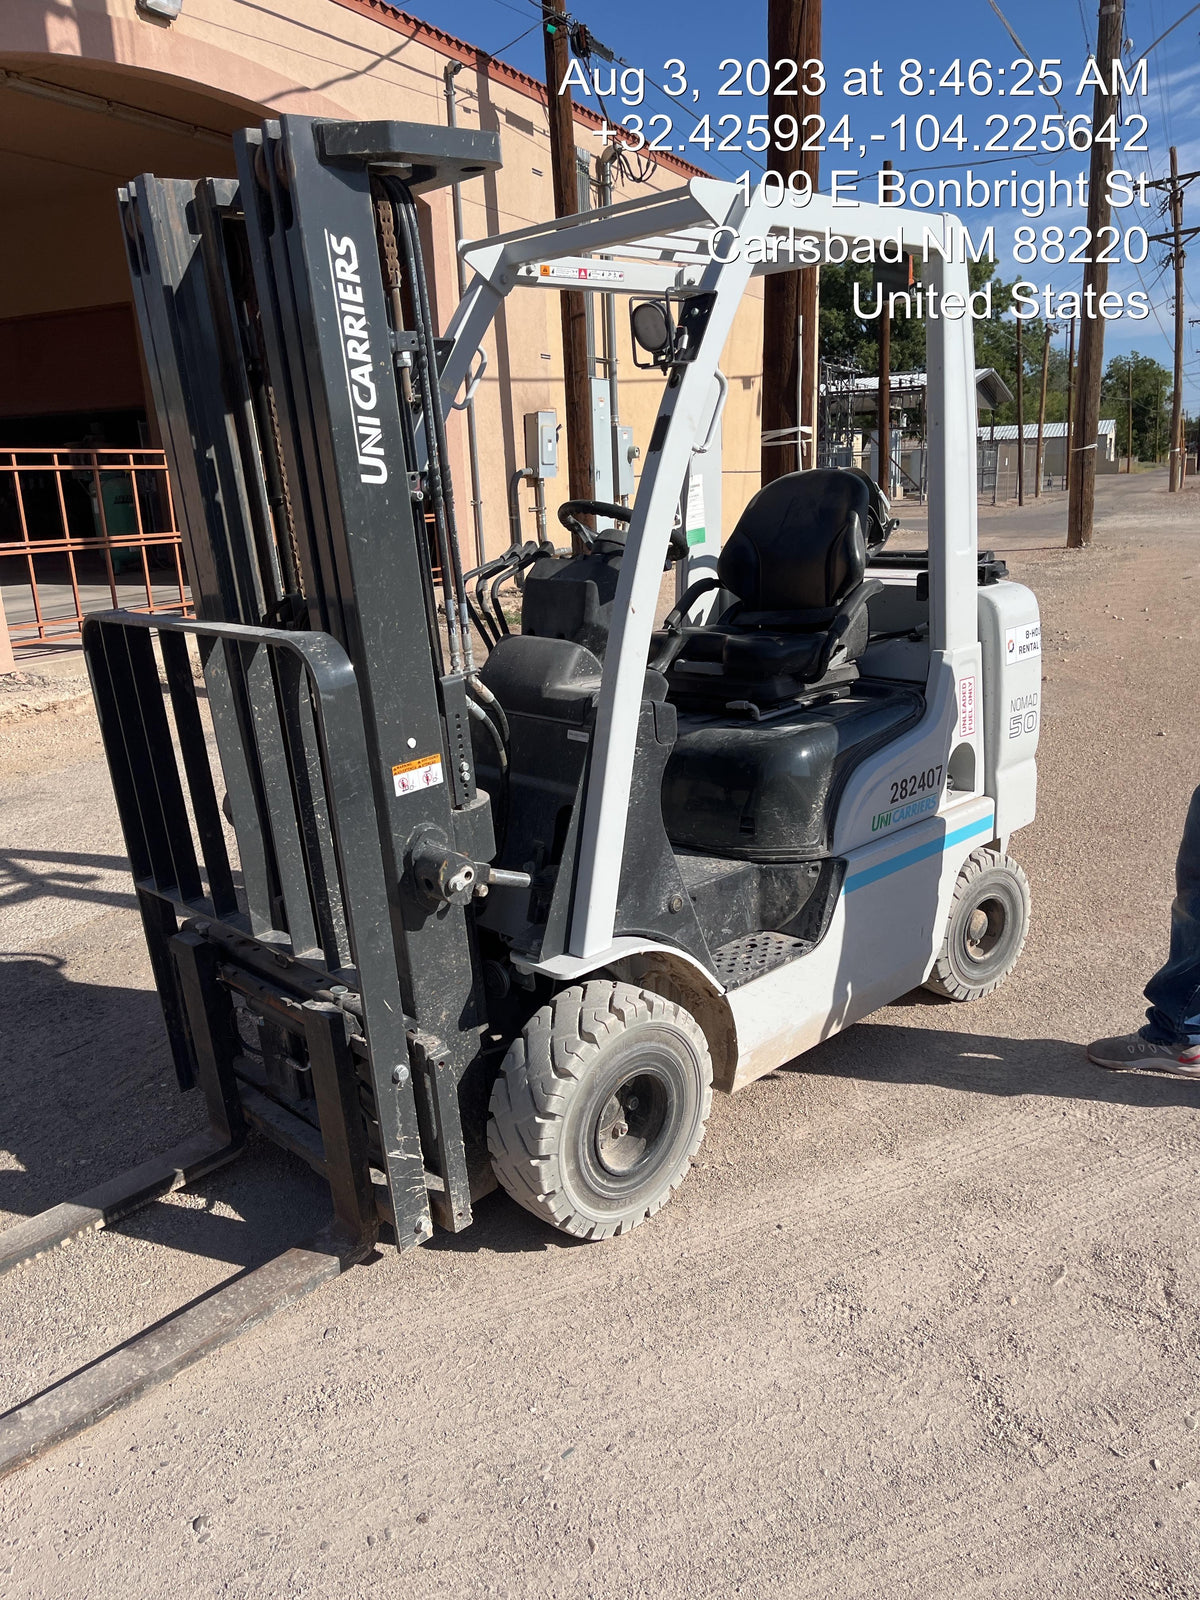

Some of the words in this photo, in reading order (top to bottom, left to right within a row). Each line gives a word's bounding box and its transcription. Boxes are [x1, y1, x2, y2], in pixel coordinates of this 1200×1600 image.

[1018, 641, 1039, 654] RENTAL
[1010, 692, 1038, 713] NOMAD
[1009, 710, 1038, 739] 50
[889, 764, 943, 805] 282407
